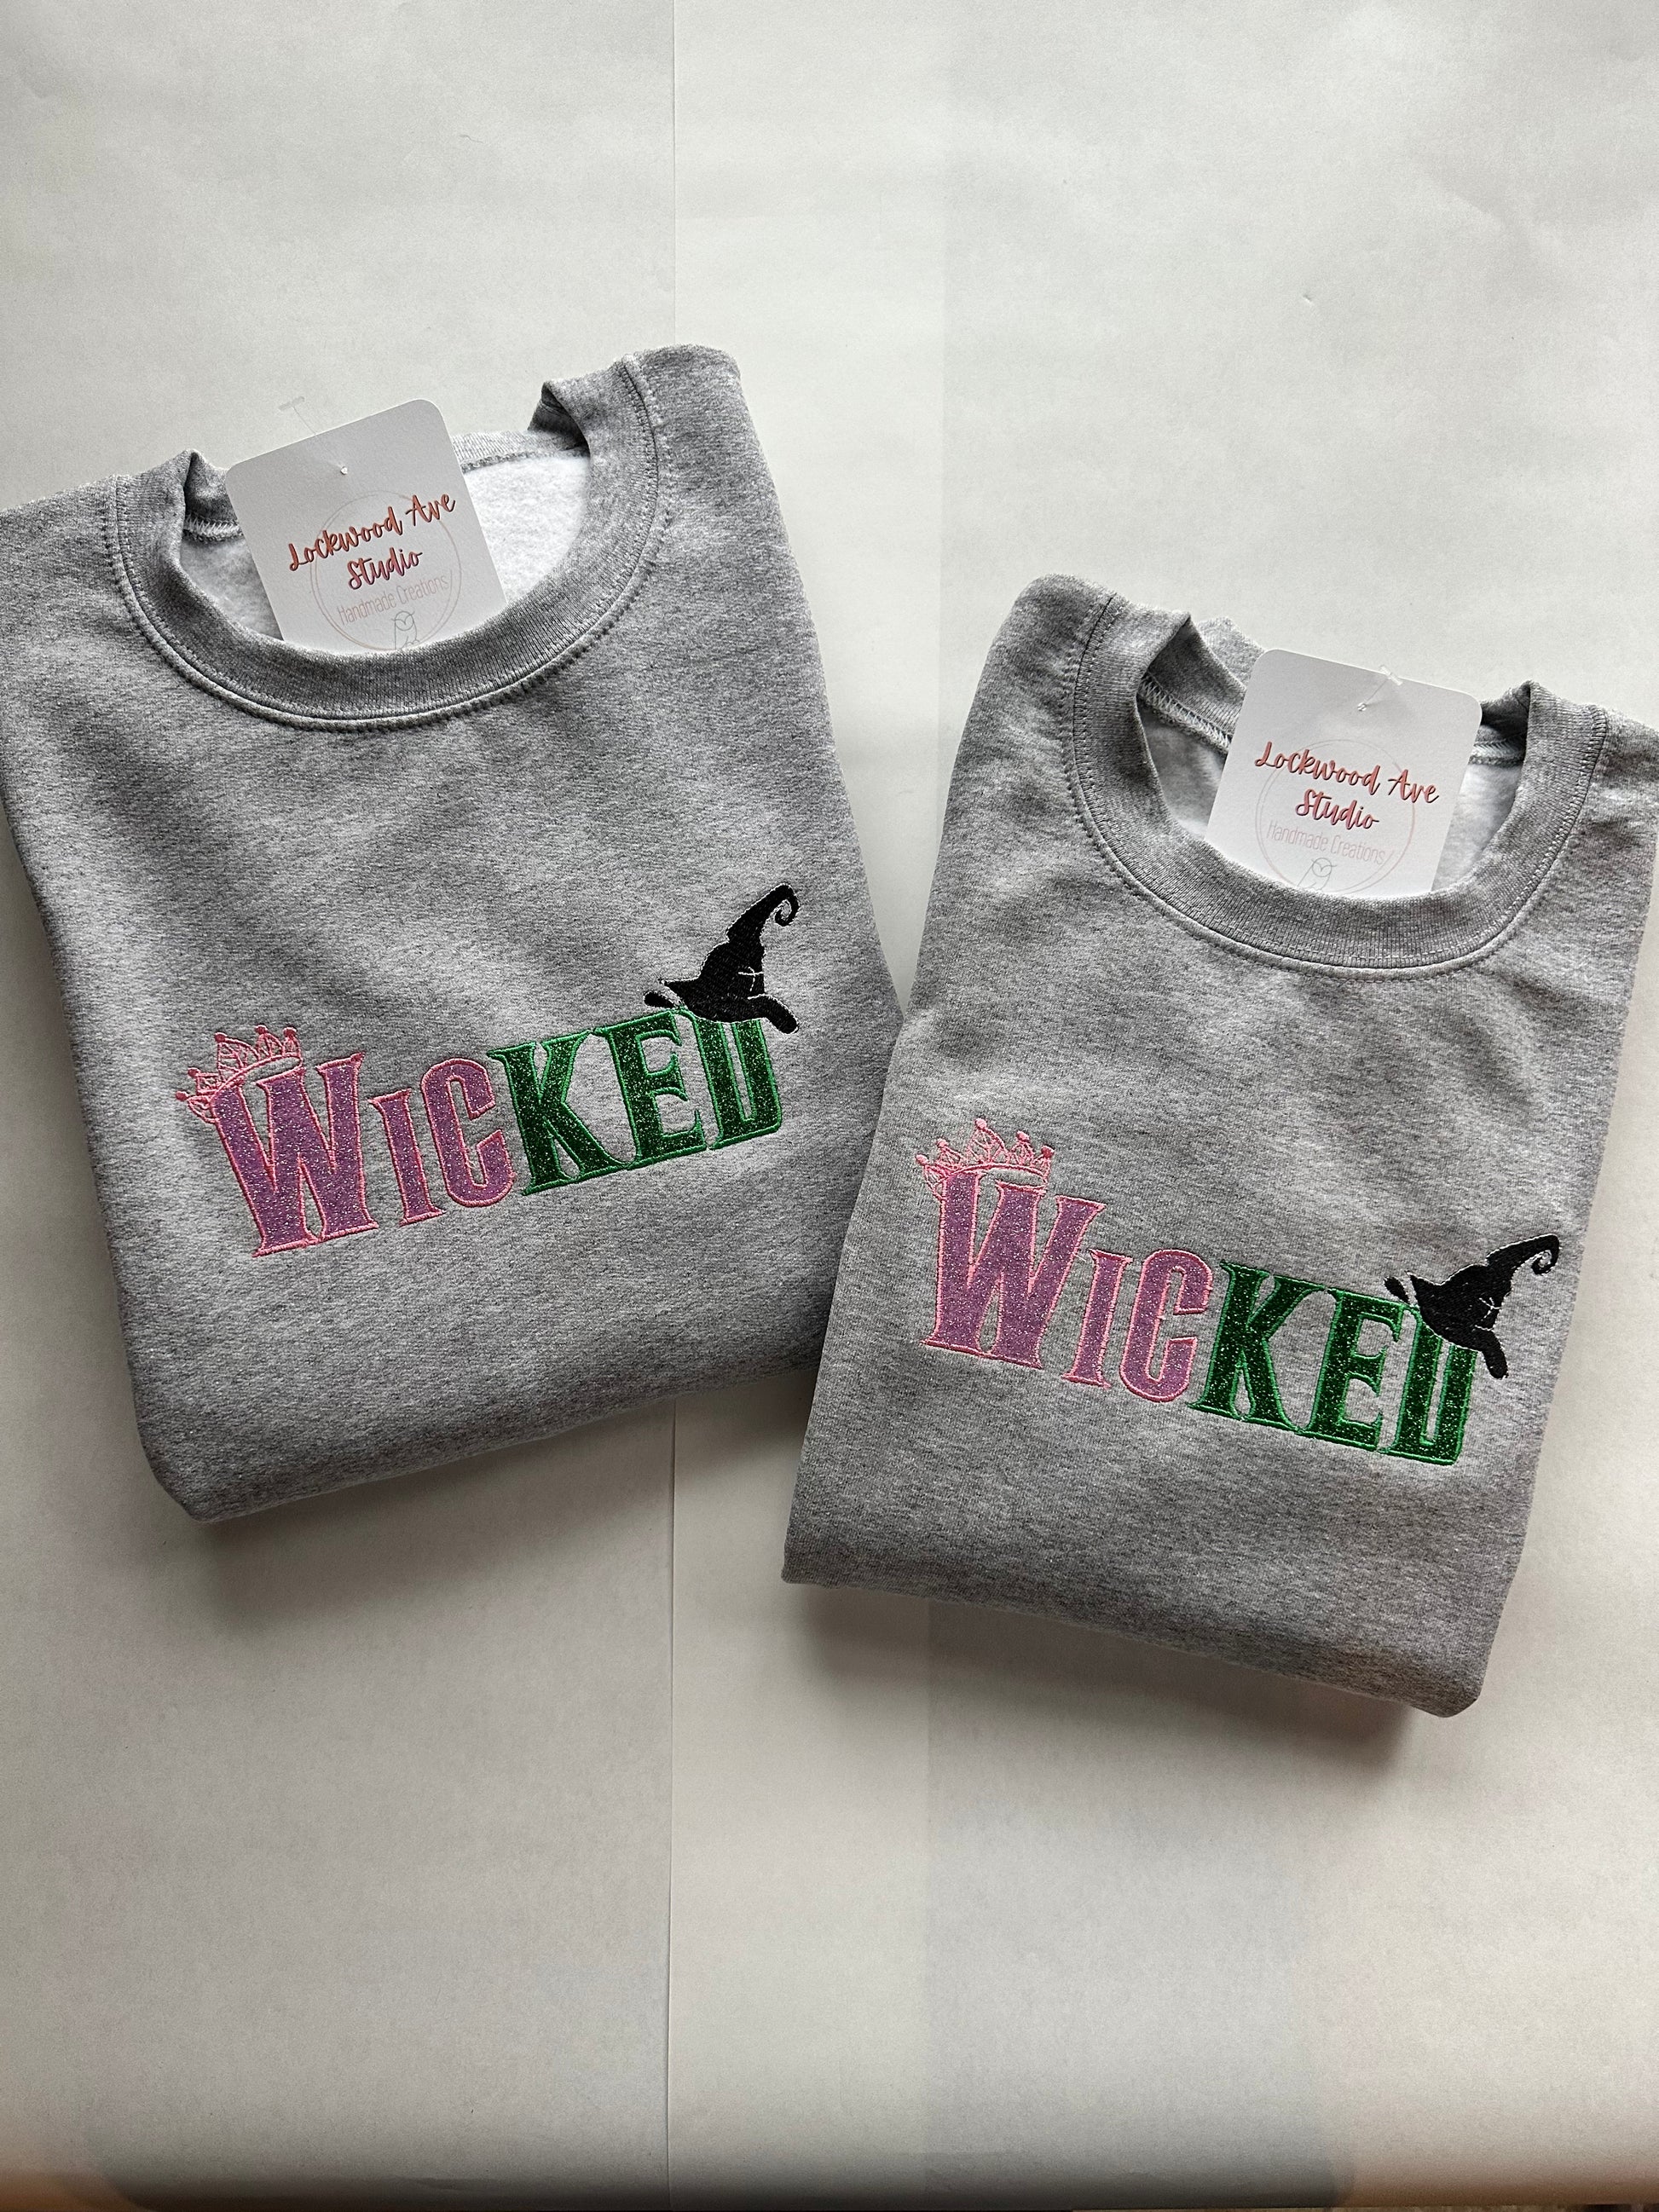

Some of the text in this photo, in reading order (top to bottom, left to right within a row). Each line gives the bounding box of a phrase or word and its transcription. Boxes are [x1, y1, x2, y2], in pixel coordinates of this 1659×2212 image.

[288, 494, 456, 571] Lockwood Ave
[346, 547, 423, 590] Studio
[336, 574, 450, 626] Handmade Creations
[1254, 741, 1439, 804] Lockwood Ave
[1294, 788, 1379, 830] Studio
[1266, 820, 1386, 865] Handmade Creations
